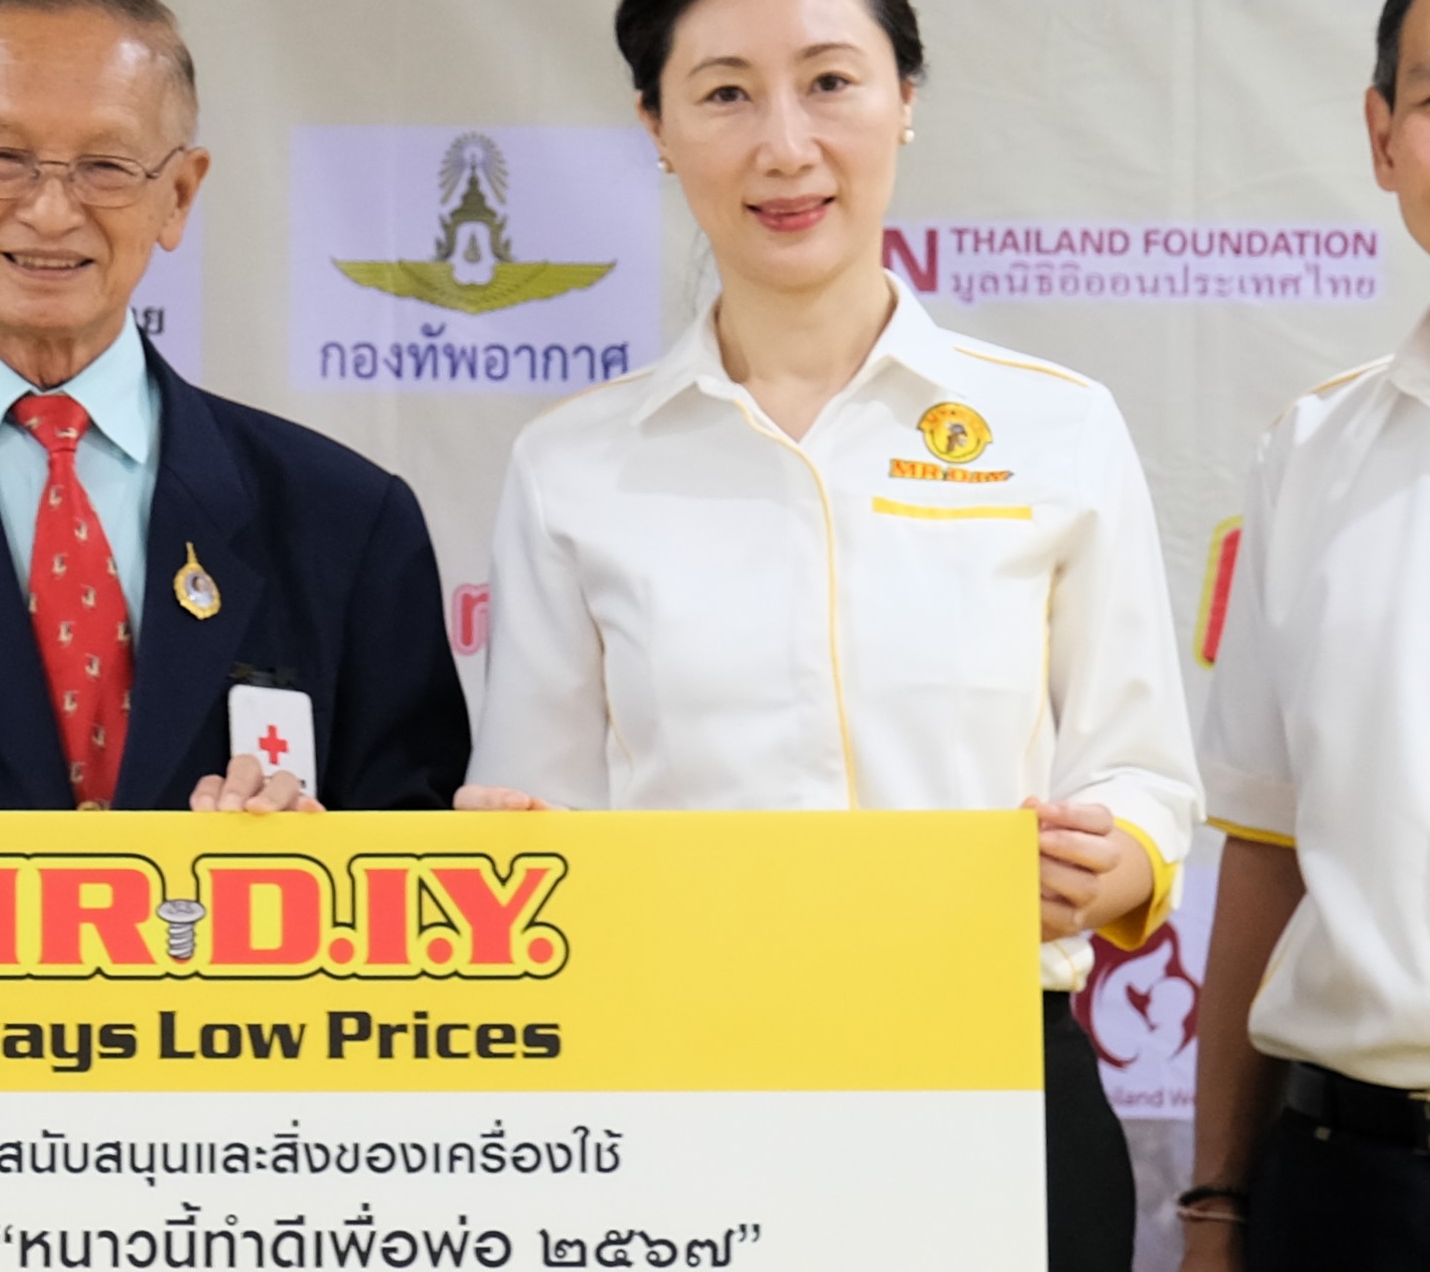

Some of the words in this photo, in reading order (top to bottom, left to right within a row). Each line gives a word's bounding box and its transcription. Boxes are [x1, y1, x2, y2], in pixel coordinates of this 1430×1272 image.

[950, 229, 1130, 257] THAILAND
[1143, 229, 1377, 257] FOUNDATION
[319, 322, 631, 384] กองทัพอากาศ
[158, 1010, 307, 1060] Low
[327, 1010, 561, 1060] Prices
